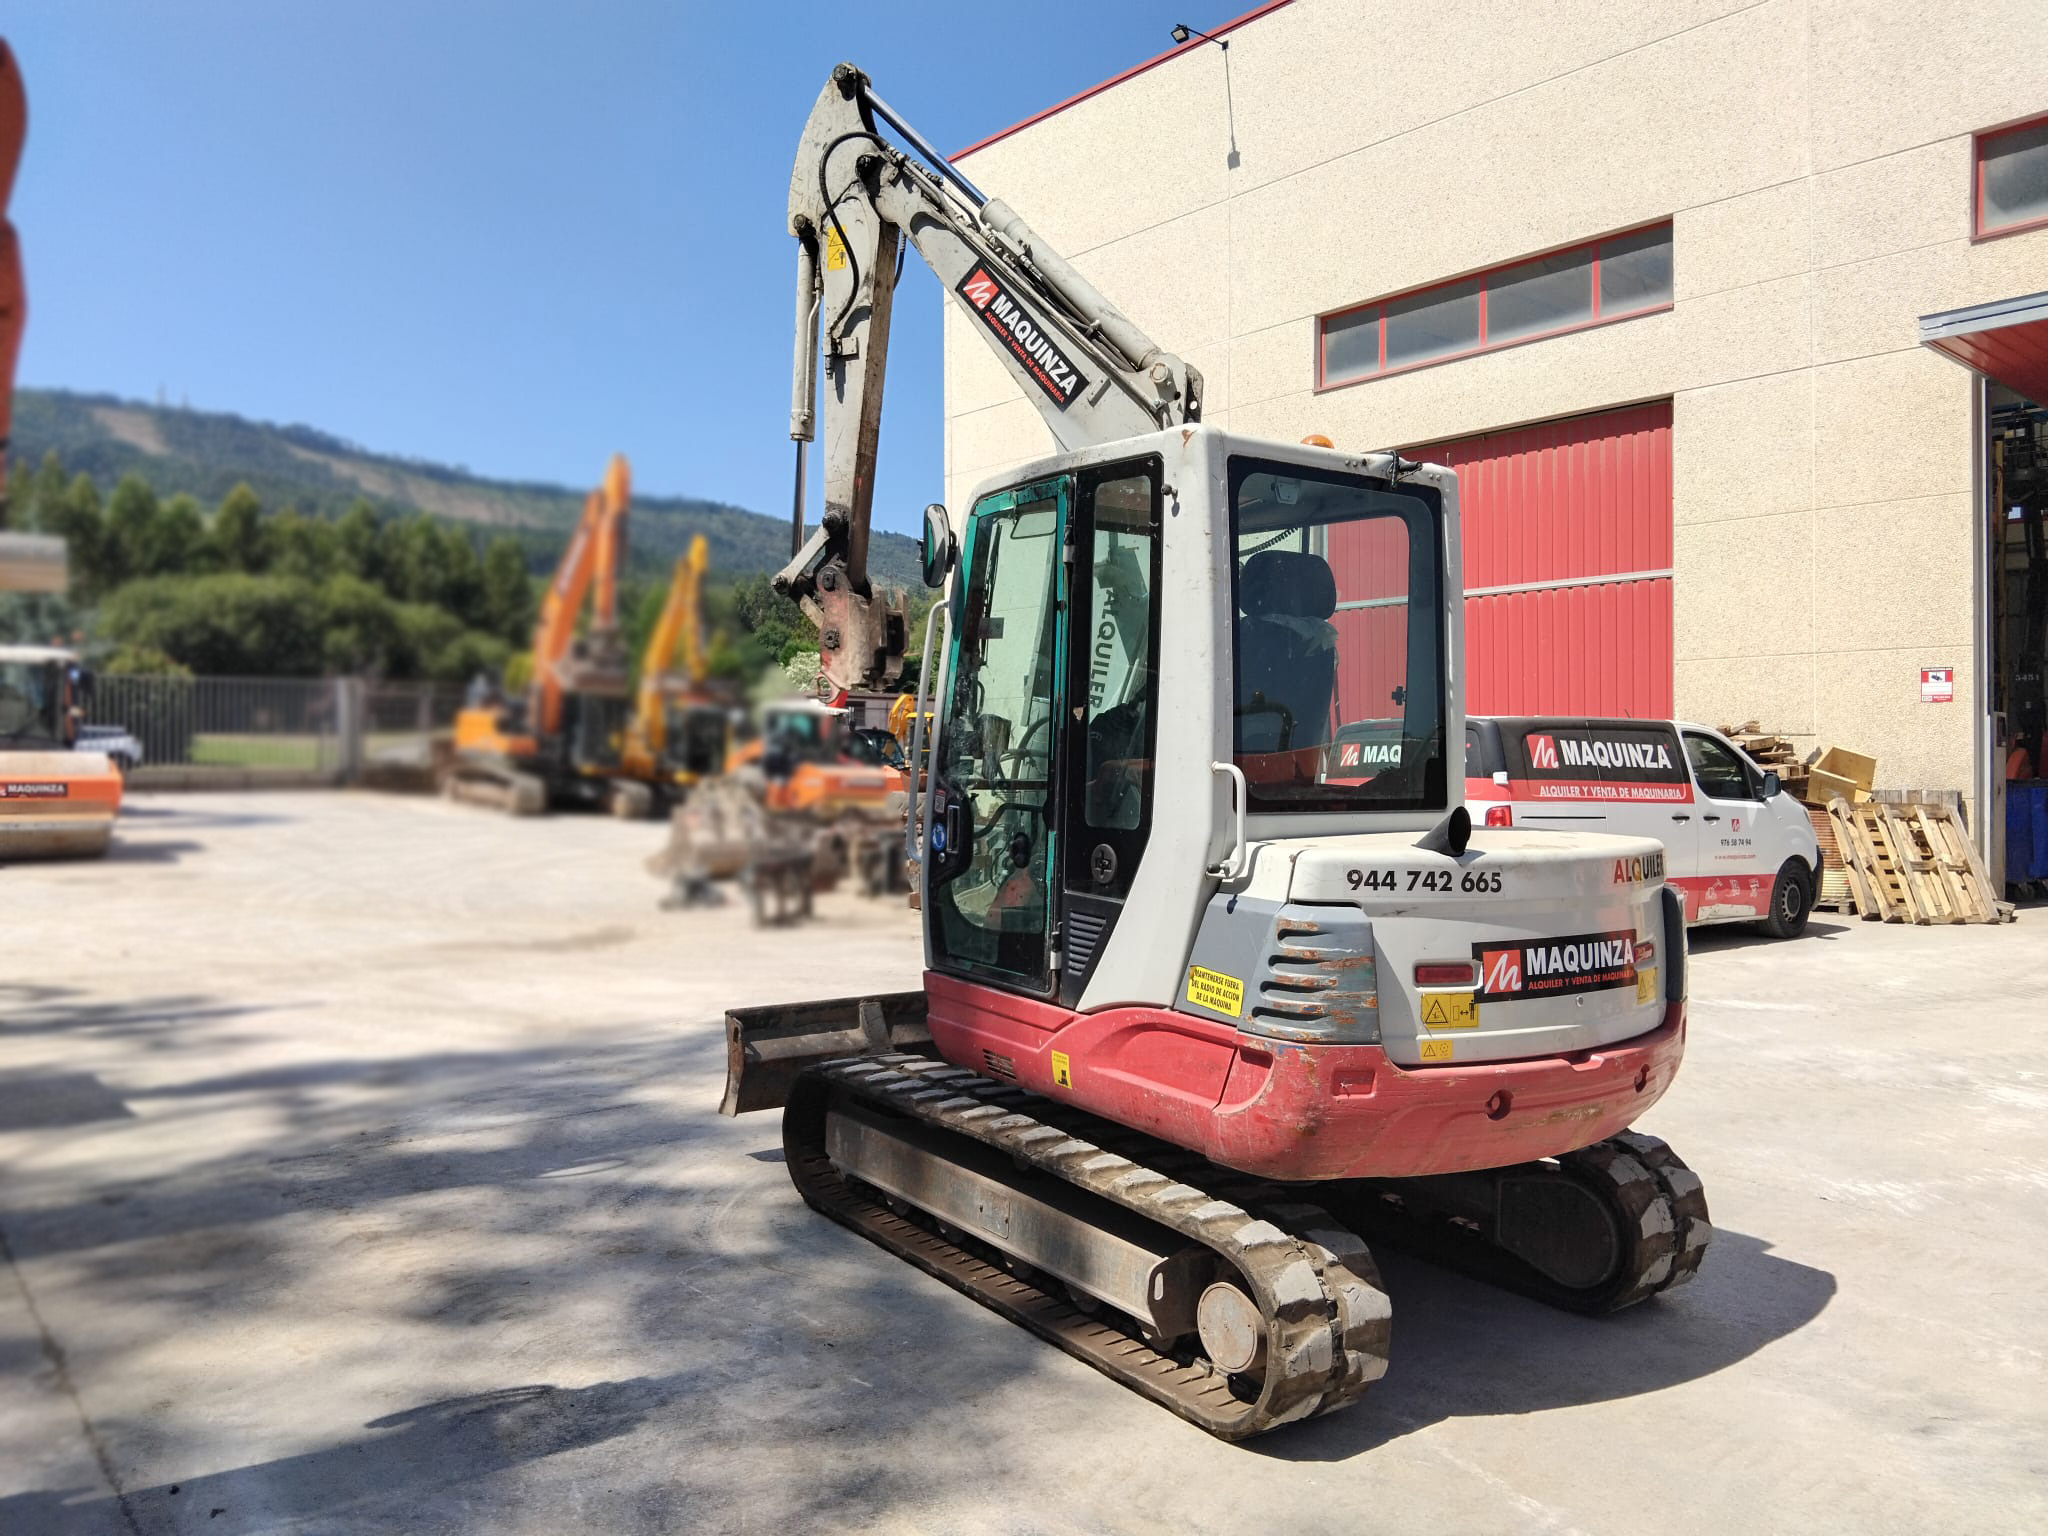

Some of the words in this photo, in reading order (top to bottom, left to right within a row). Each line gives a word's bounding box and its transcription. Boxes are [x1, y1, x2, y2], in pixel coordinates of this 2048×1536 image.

[990, 293, 1078, 396] MAQUINZA
[984, 311, 1008, 338] ALQUILER
[1011, 341, 1028, 360] VENTA
[1026, 357, 1034, 368] DE
[1032, 365, 1066, 404] MAQUINARIA
[1560, 739, 1672, 769] MAQUINZA
[8, 784, 65, 793] MAQUINZA
[1540, 785, 1581, 798] ALQUILER
[1582, 786, 1589, 798] Y
[1590, 786, 1617, 798] VENTA
[1619, 787, 1630, 798] DE
[1631, 787, 1681, 799] MAQUINARIA
[1738, 838, 1744, 846] 74
[1614, 853, 1665, 884] ALQUILER
[1346, 869, 1397, 891] 944
[1406, 870, 1452, 892] 742
[1461, 871, 1502, 893] 665
[1526, 938, 1634, 976] MAQUINZA
[1191, 979, 1199, 989] DEL
[1200, 982, 1214, 993] RADIO
[1215, 986, 1222, 996] DE
[1194, 968, 1224, 985] MANTENERSE
[1224, 978, 1239, 990] FUERA
[1528, 979, 1563, 990] ALQUILER
[1564, 978, 1570, 986] Y
[1571, 976, 1592, 986] VENTA
[1593, 974, 1601, 983] DE
[1602, 970, 1635, 982] MAQUINARIA
[1196, 991, 1202, 1001] DE
[1203, 994, 1208, 1003] LA
